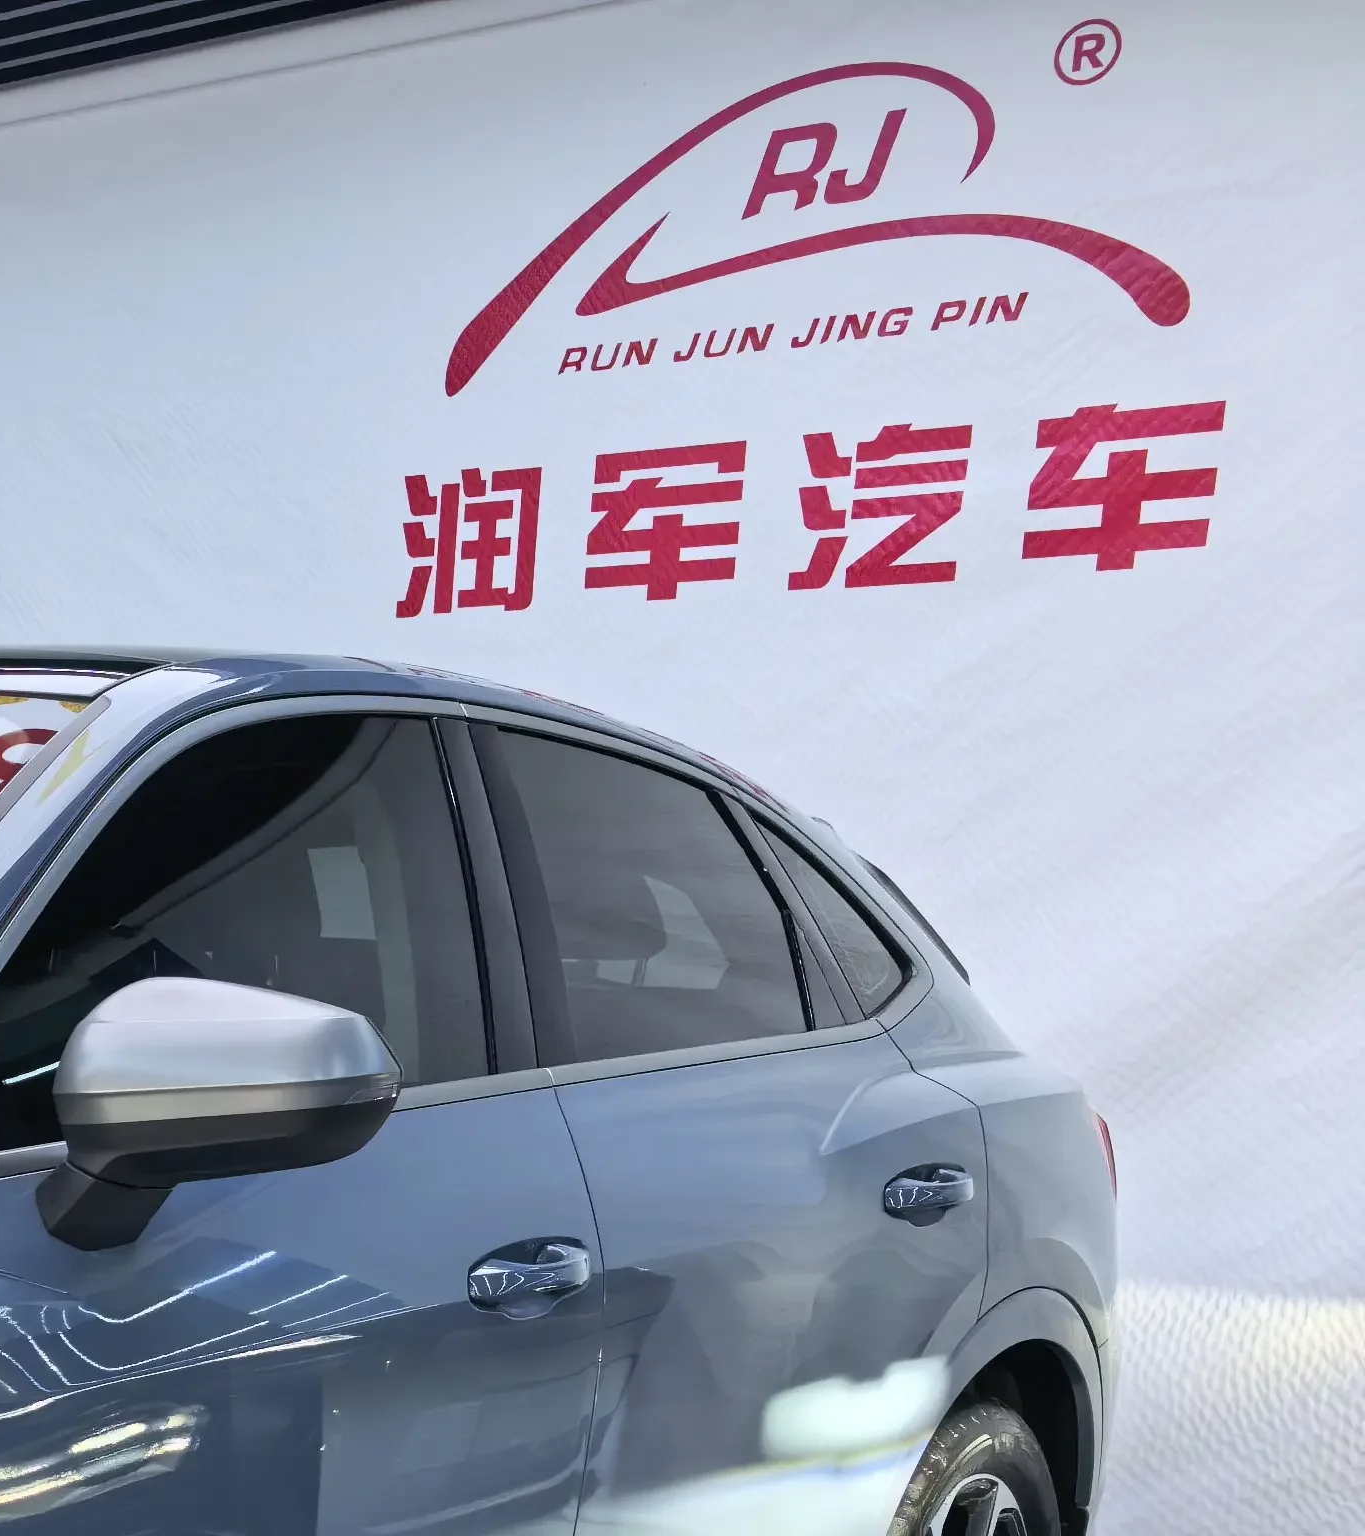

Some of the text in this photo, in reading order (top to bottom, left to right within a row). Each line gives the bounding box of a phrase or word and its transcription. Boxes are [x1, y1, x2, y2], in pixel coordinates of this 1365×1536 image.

[741, 108, 907, 220] RJ
[557, 292, 1029, 375] RUN JUN JING PIN
[396, 400, 1226, 619] 润军汽车
